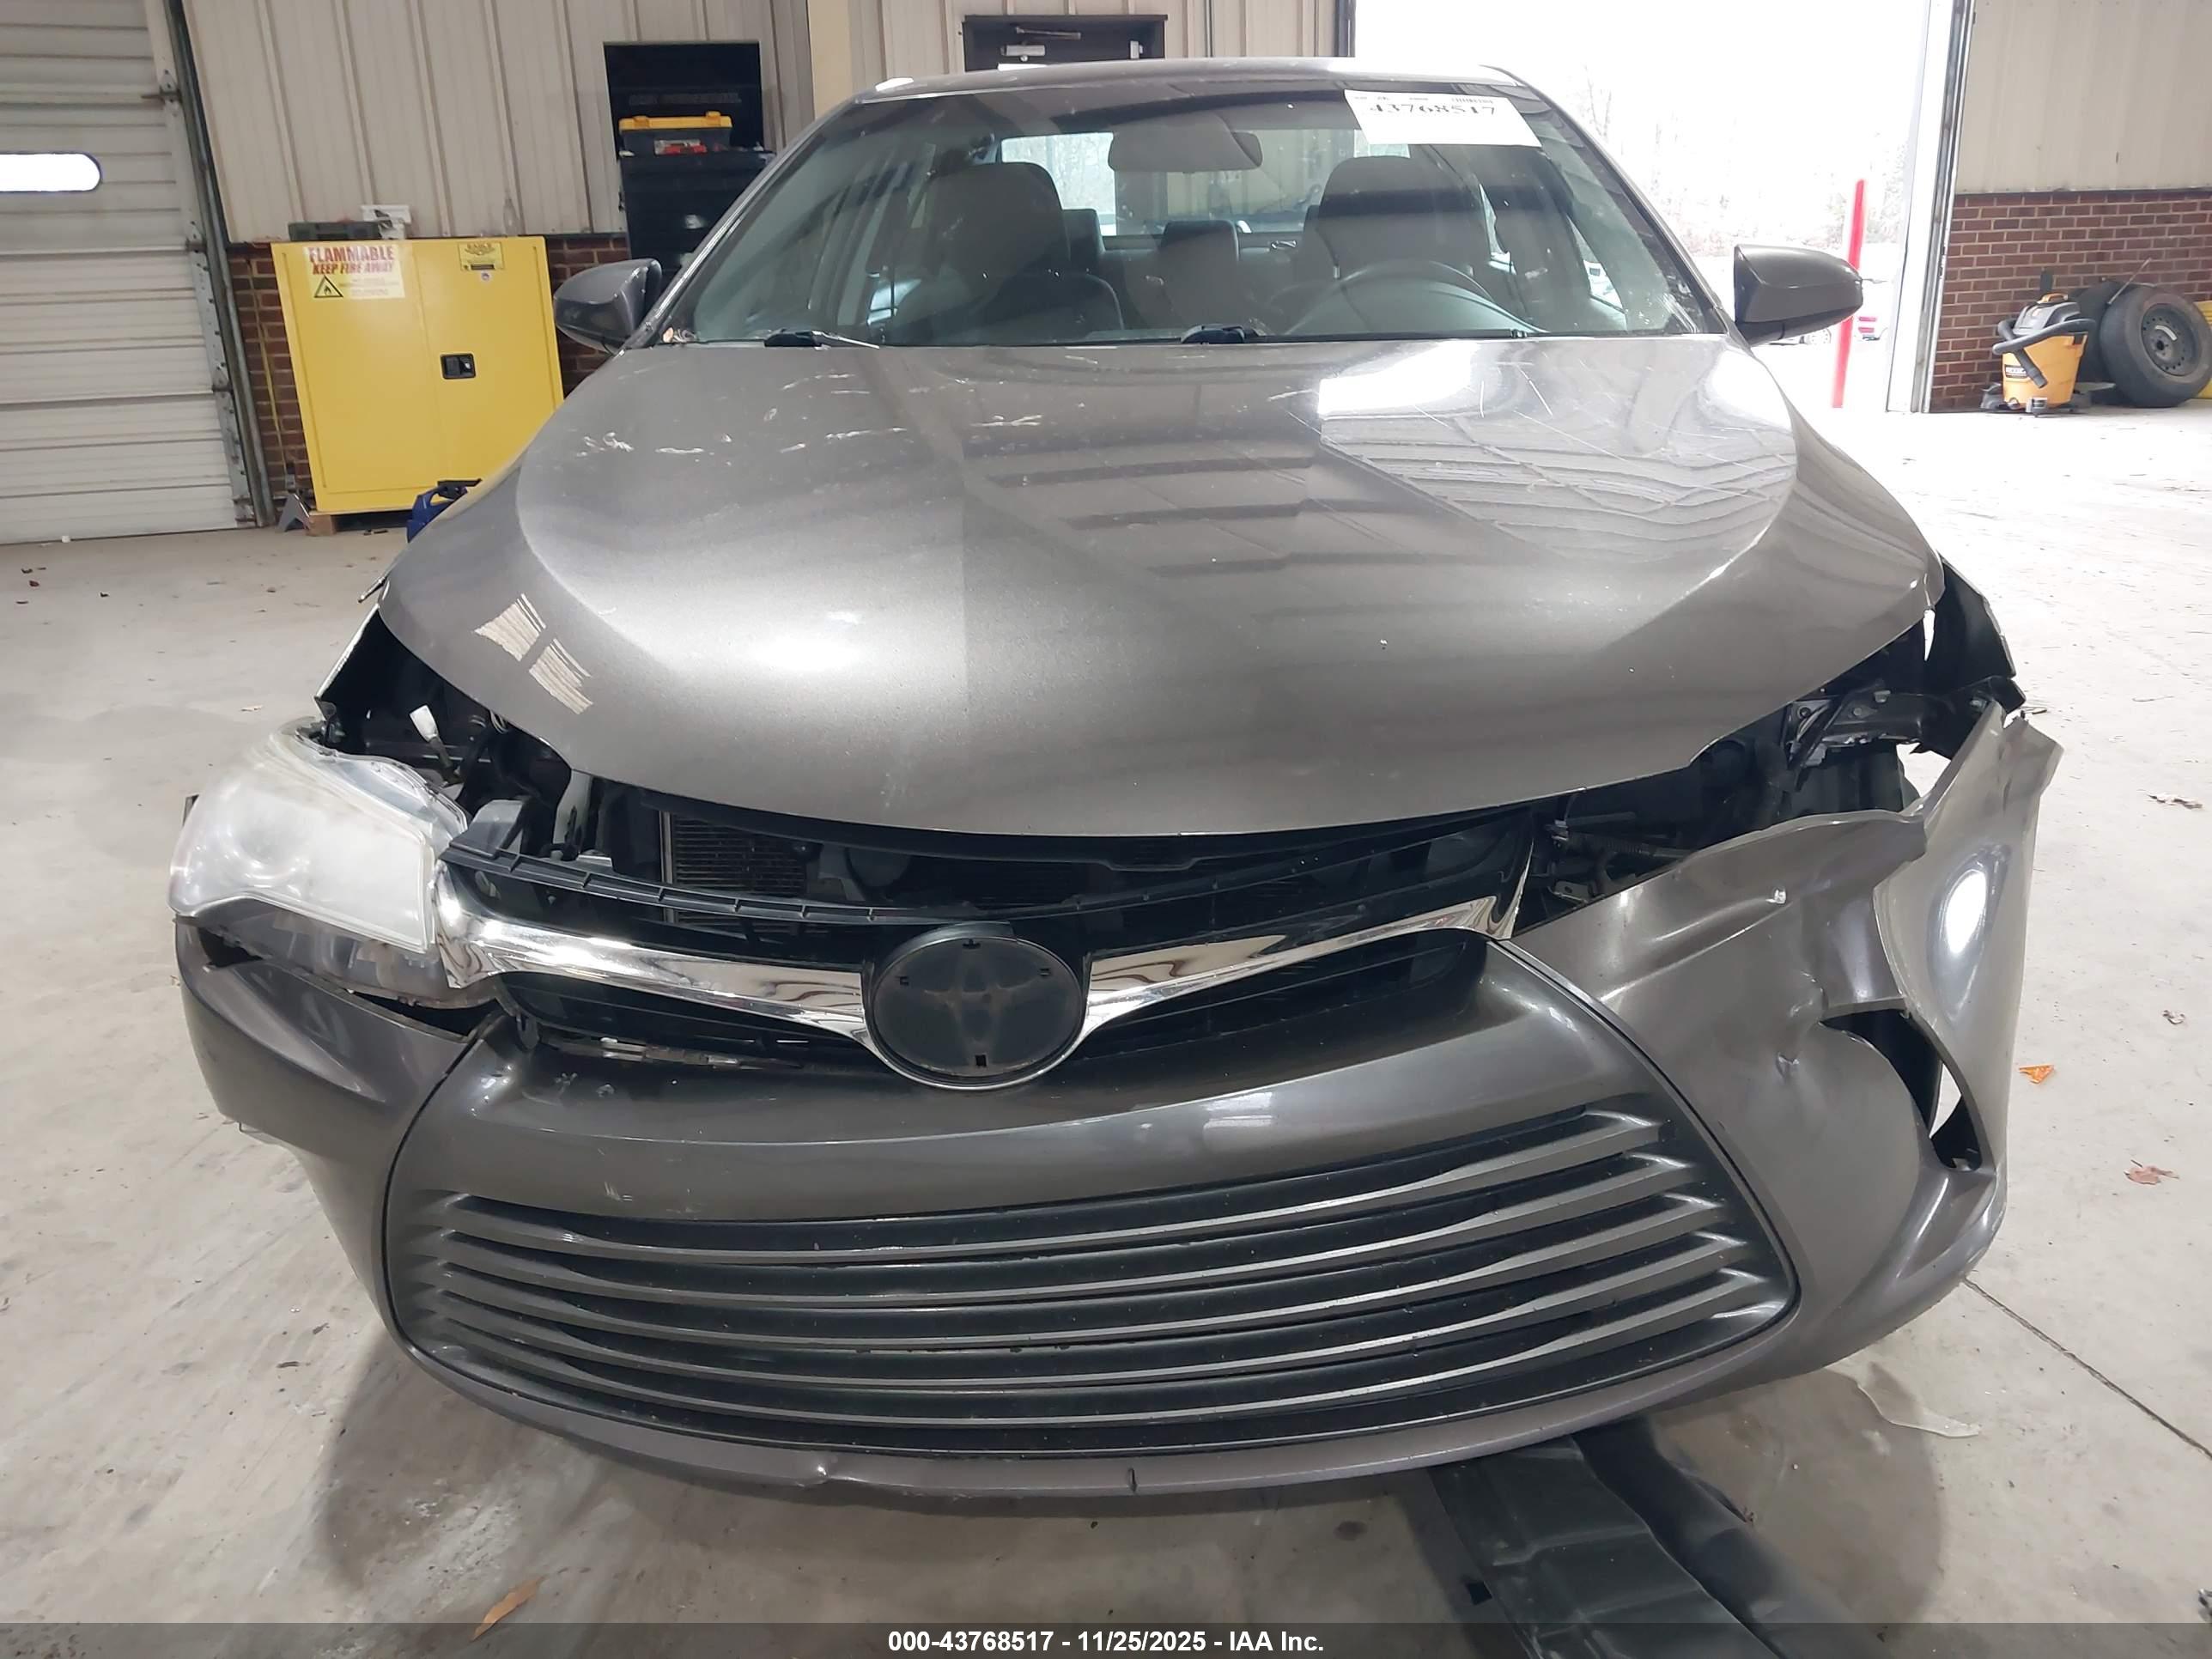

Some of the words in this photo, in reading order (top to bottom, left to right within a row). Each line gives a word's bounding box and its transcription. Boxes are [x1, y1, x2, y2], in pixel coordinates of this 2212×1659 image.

[309, 246, 394, 262] FLAMMABLE
[313, 263, 337, 275] KEEP
[340, 262, 364, 274] FIRE
